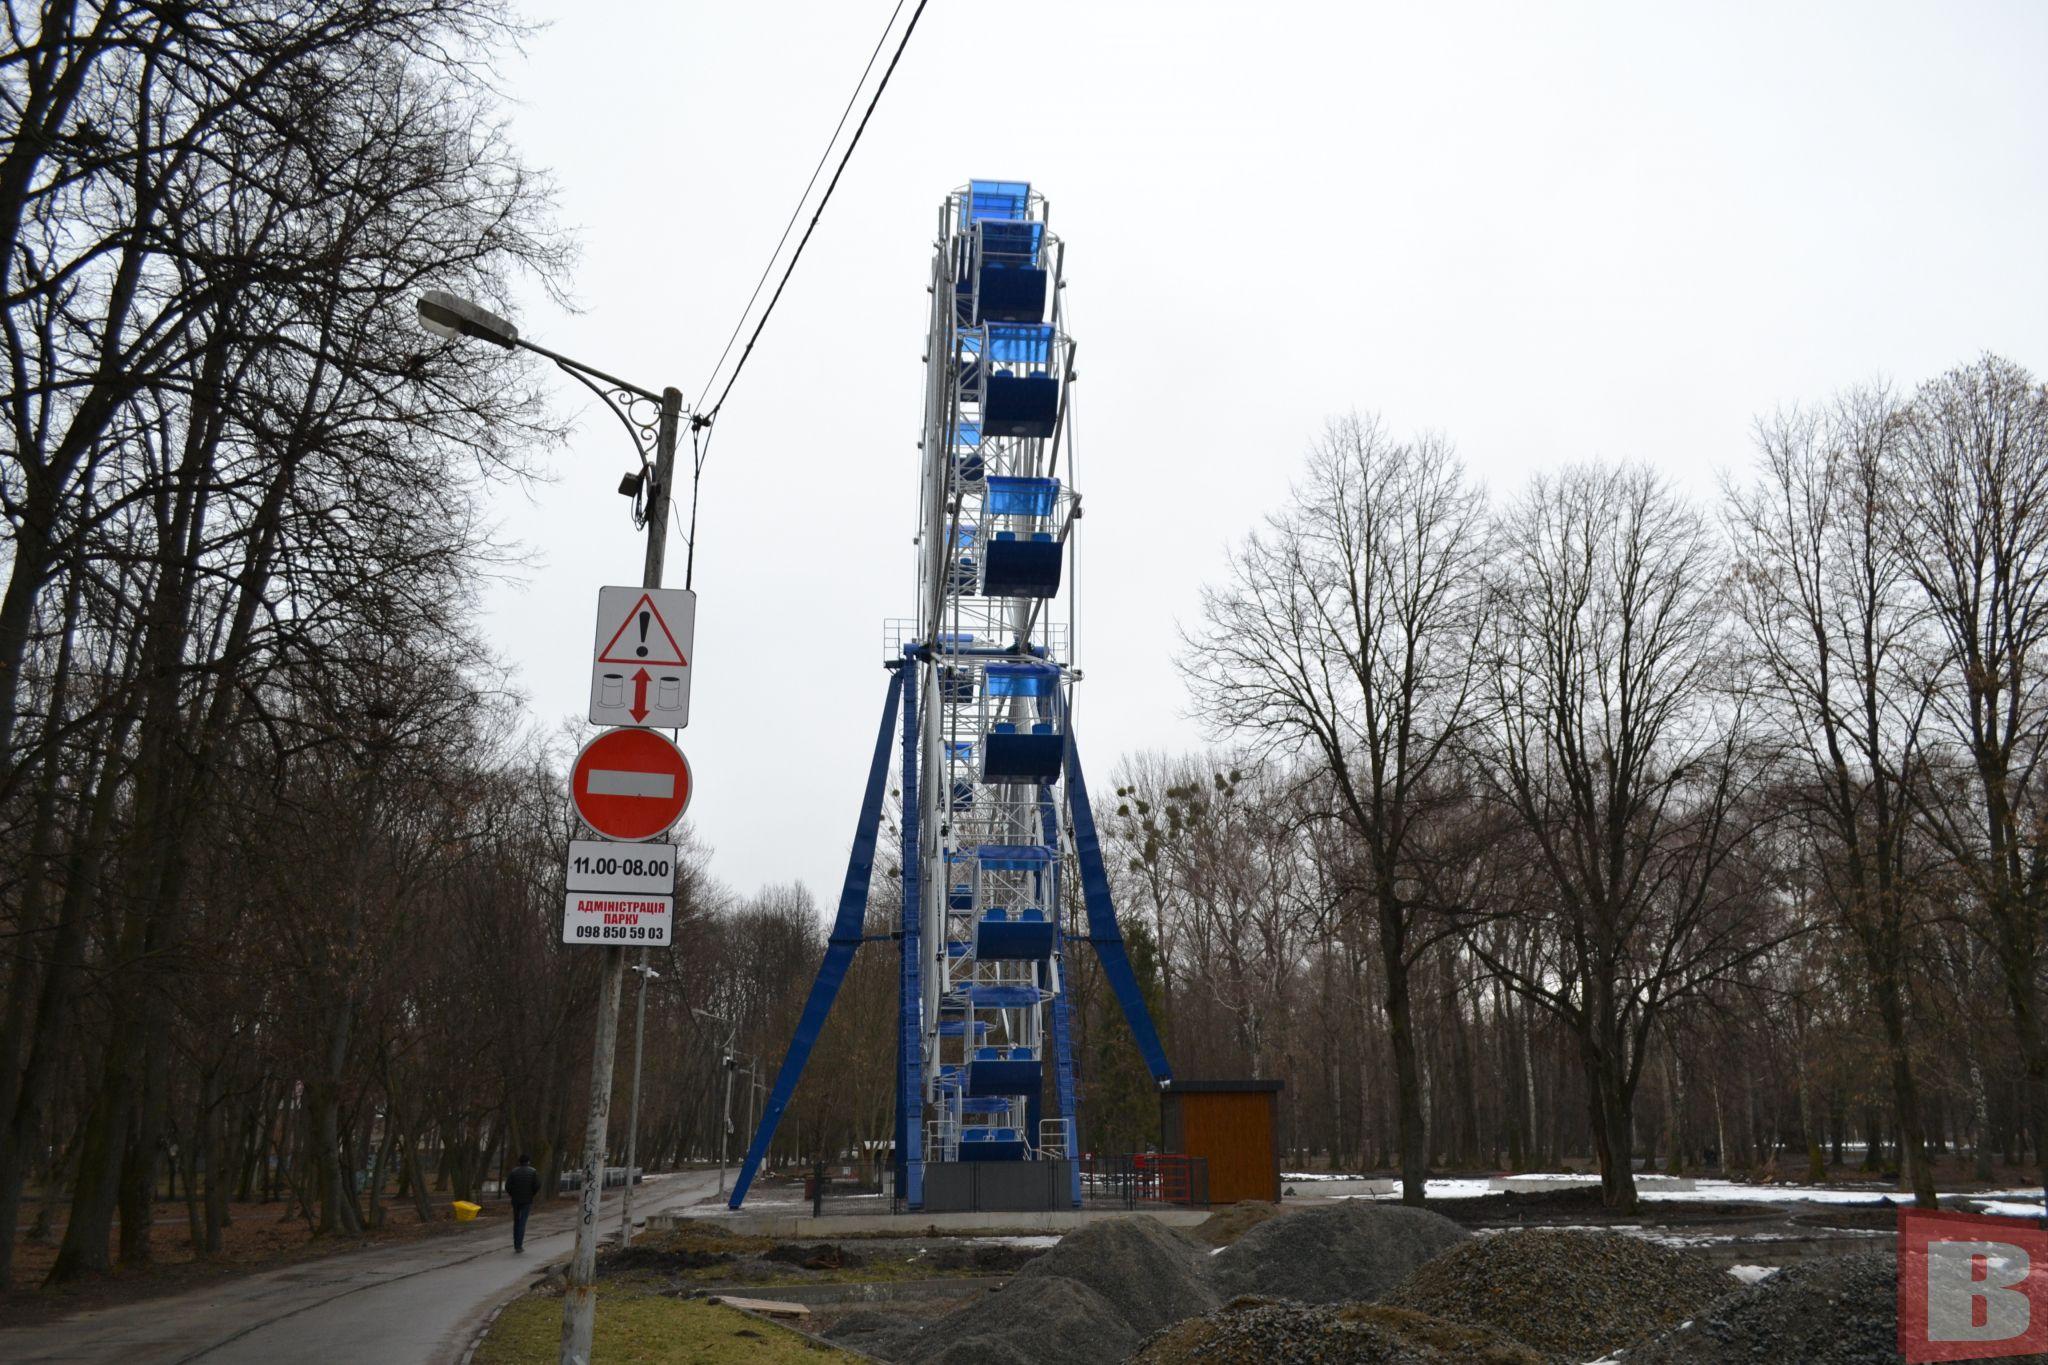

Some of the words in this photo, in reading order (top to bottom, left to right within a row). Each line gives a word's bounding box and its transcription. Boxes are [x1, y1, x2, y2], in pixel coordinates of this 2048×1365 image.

[574, 857, 669, 877] 11.00-08.00
[577, 900, 665, 914] АДМІНІСТРАЦІЯ
[603, 913, 639, 925] ПАРКУ
[576, 925, 600, 938] 098
[603, 926, 626, 939] 850
[629, 927, 645, 939] 59
[648, 927, 663, 940] 03
